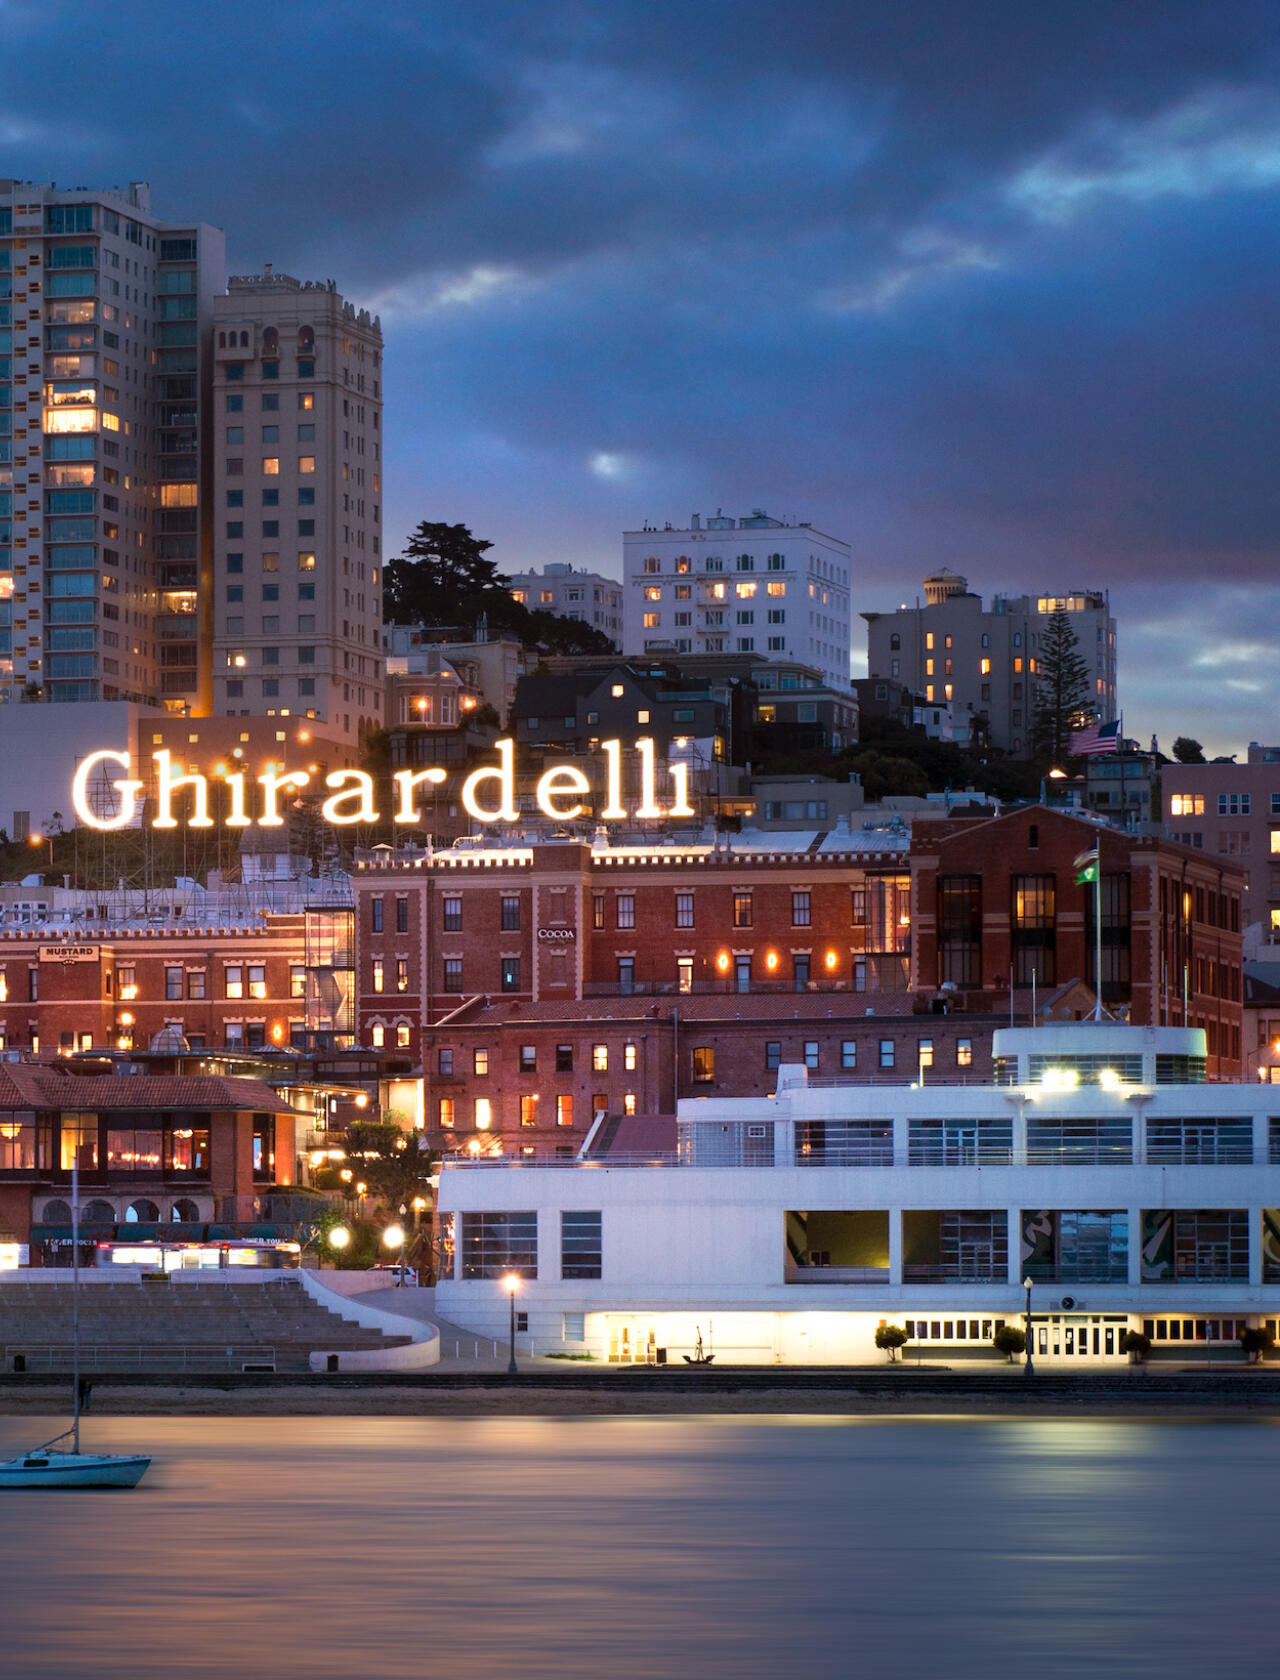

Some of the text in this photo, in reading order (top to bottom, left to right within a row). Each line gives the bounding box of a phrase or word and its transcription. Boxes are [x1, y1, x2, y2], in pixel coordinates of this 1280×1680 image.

[72, 737, 696, 831] Ghirardelli
[538, 929, 574, 938] COCOA
[46, 948, 93, 956] MUSTARD
